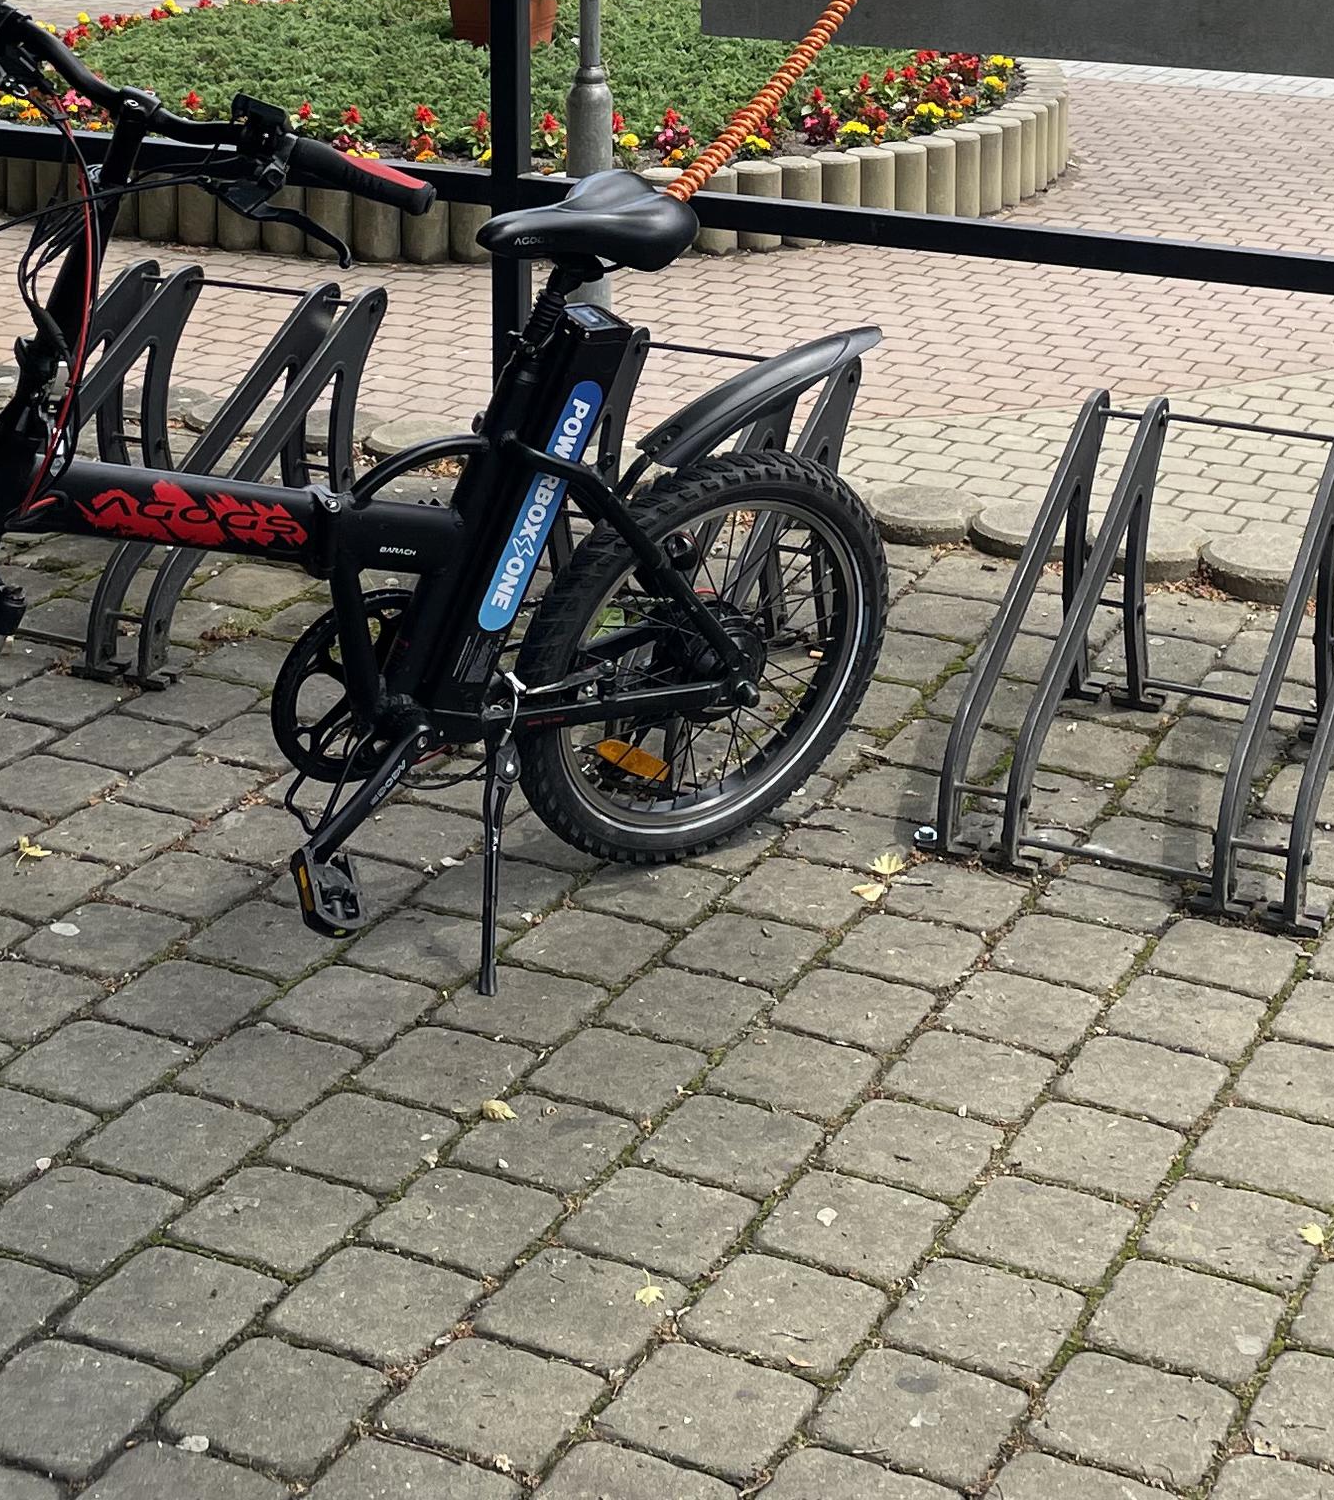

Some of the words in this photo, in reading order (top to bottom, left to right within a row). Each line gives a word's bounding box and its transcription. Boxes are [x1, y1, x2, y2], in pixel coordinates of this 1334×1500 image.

[519, 398, 591, 542] POWRBOX
[379, 546, 417, 556] BARACH
[491, 556, 525, 611] ONE
